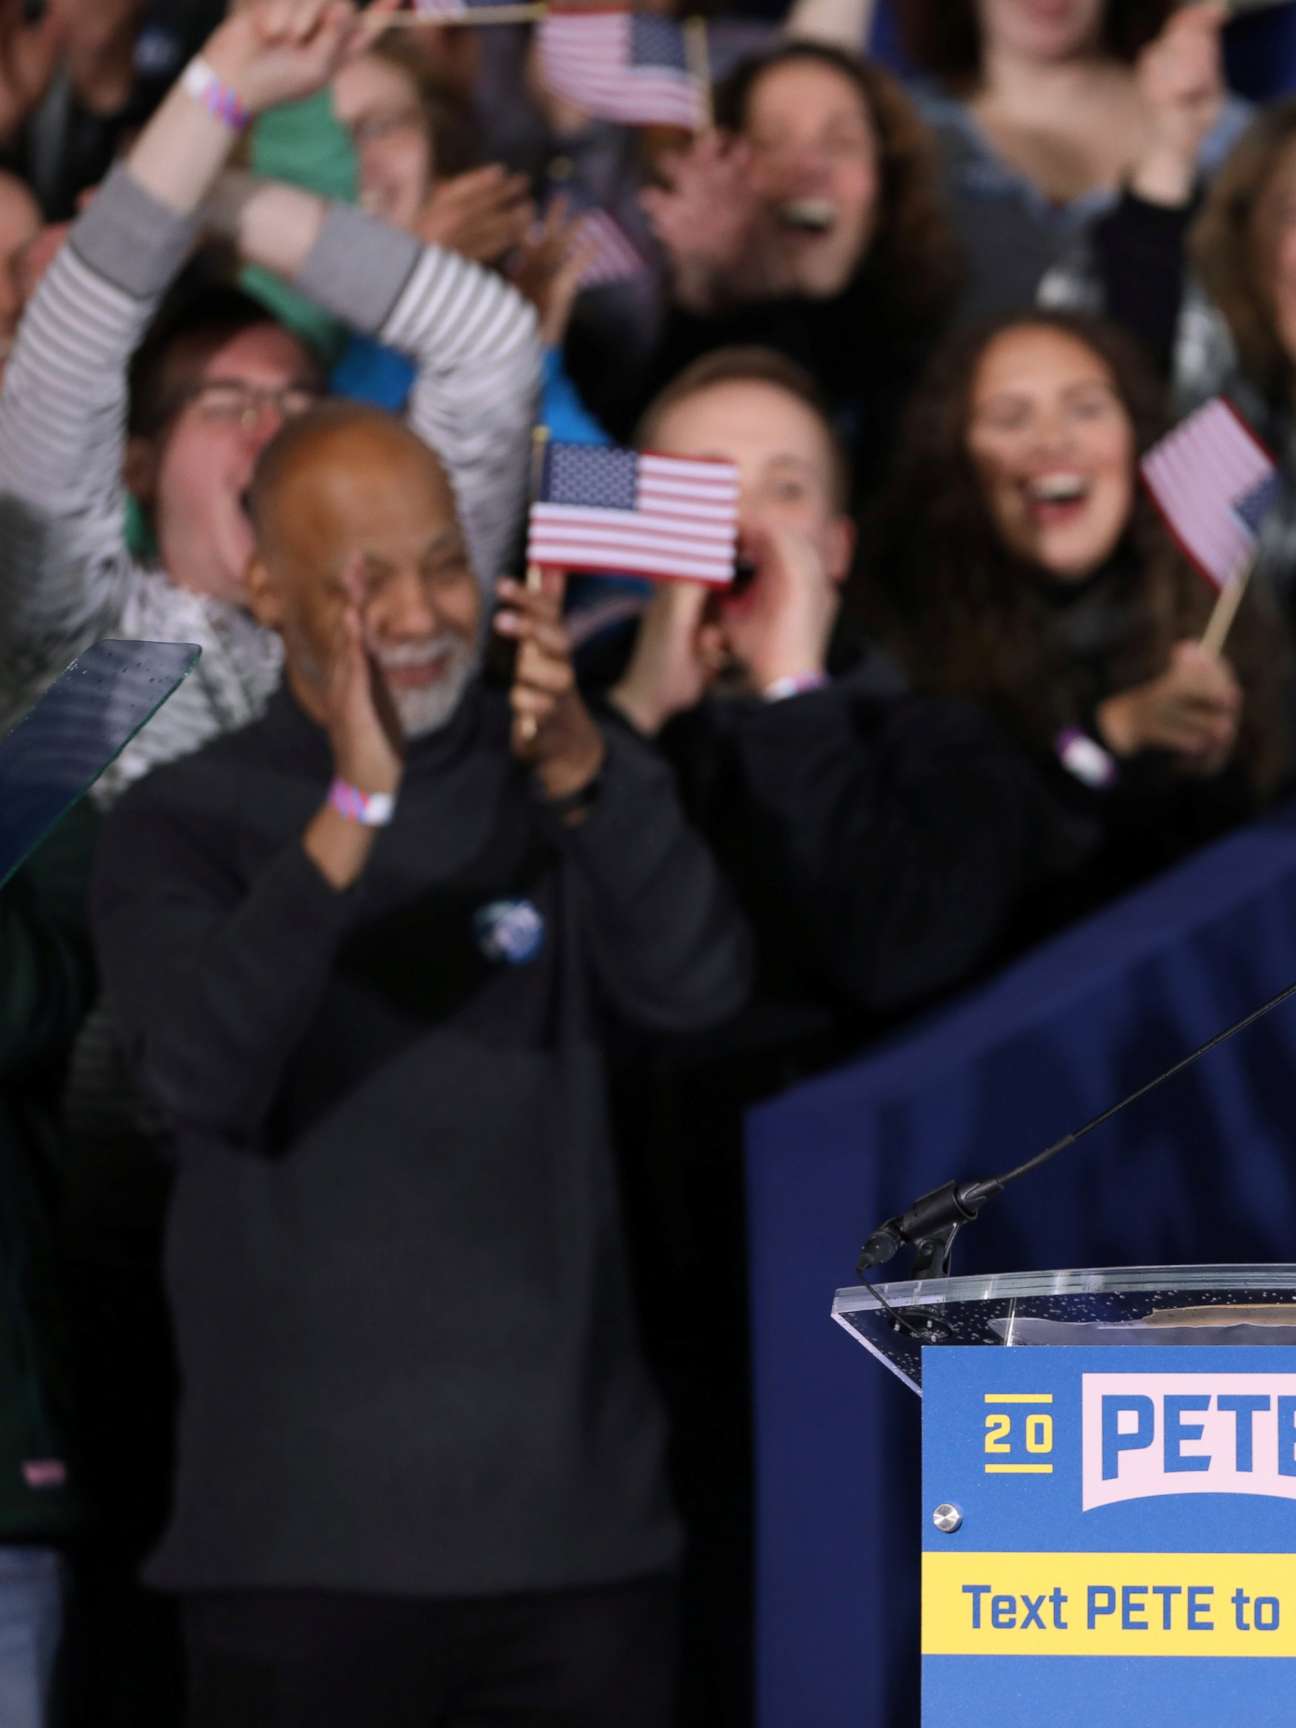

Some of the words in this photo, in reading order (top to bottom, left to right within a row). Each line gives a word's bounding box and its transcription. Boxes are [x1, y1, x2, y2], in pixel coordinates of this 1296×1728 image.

[985, 1414, 1053, 1453] 20
[962, 1584, 1068, 1629] Text
[1087, 1586, 1214, 1631] PETE
[1232, 1588, 1280, 1631] to
